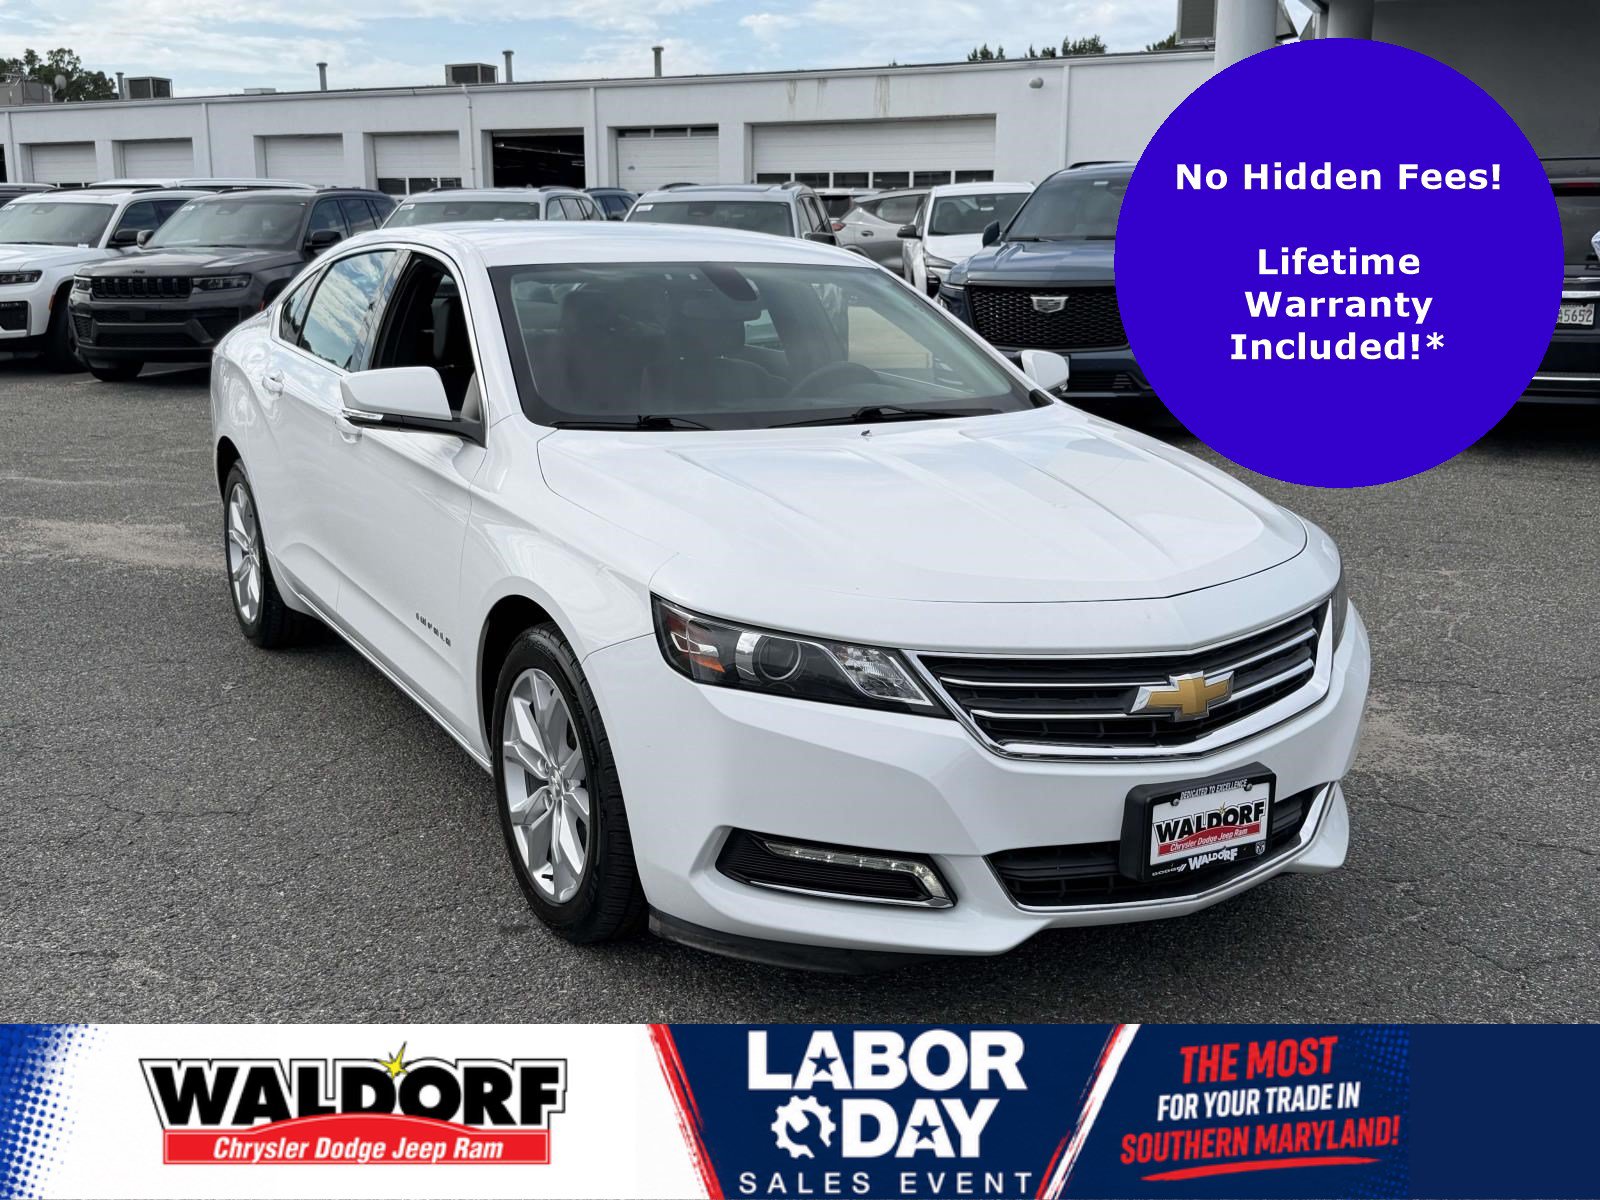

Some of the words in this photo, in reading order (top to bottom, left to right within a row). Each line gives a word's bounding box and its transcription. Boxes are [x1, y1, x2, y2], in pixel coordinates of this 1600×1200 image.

[1180, 786, 1208, 800] DEDICATED
[1209, 785, 1216, 794] TO
[1216, 779, 1248, 793] EXCELLENCE
[1155, 801, 1266, 843] WALDORF
[1170, 840, 1197, 852] Chrysler
[1197, 834, 1217, 846] Dodge
[1218, 831, 1234, 842] Jeep
[1234, 828, 1248, 837] Ram
[1188, 848, 1238, 870] WALDORF
